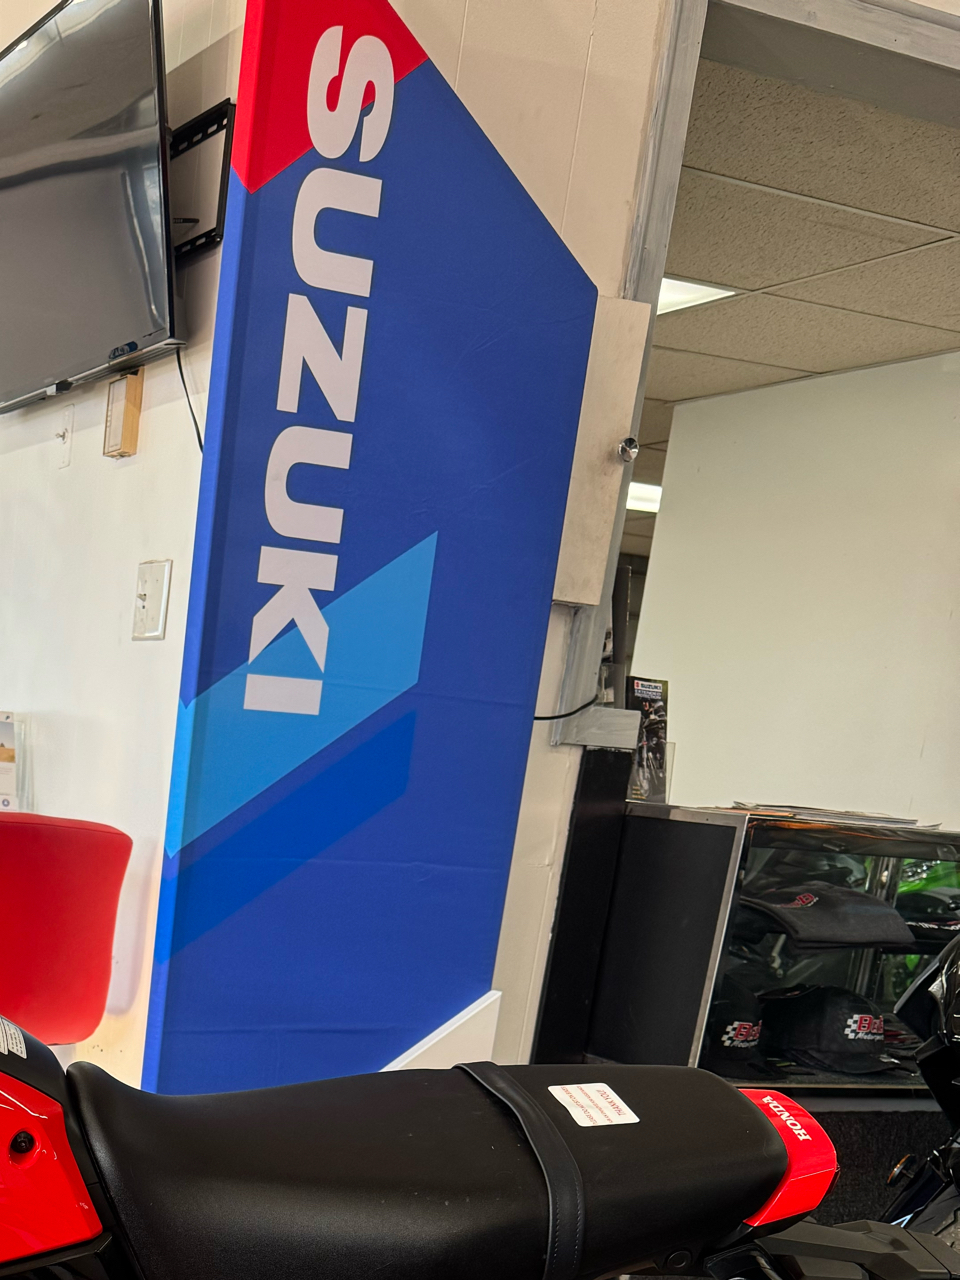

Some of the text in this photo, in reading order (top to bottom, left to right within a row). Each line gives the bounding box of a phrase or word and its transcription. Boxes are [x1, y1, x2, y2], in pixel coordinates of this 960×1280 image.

[243, 25, 395, 716] SUZUKI
[604, 1099, 627, 1116] THANK
[762, 1095, 812, 1141] HONDA
